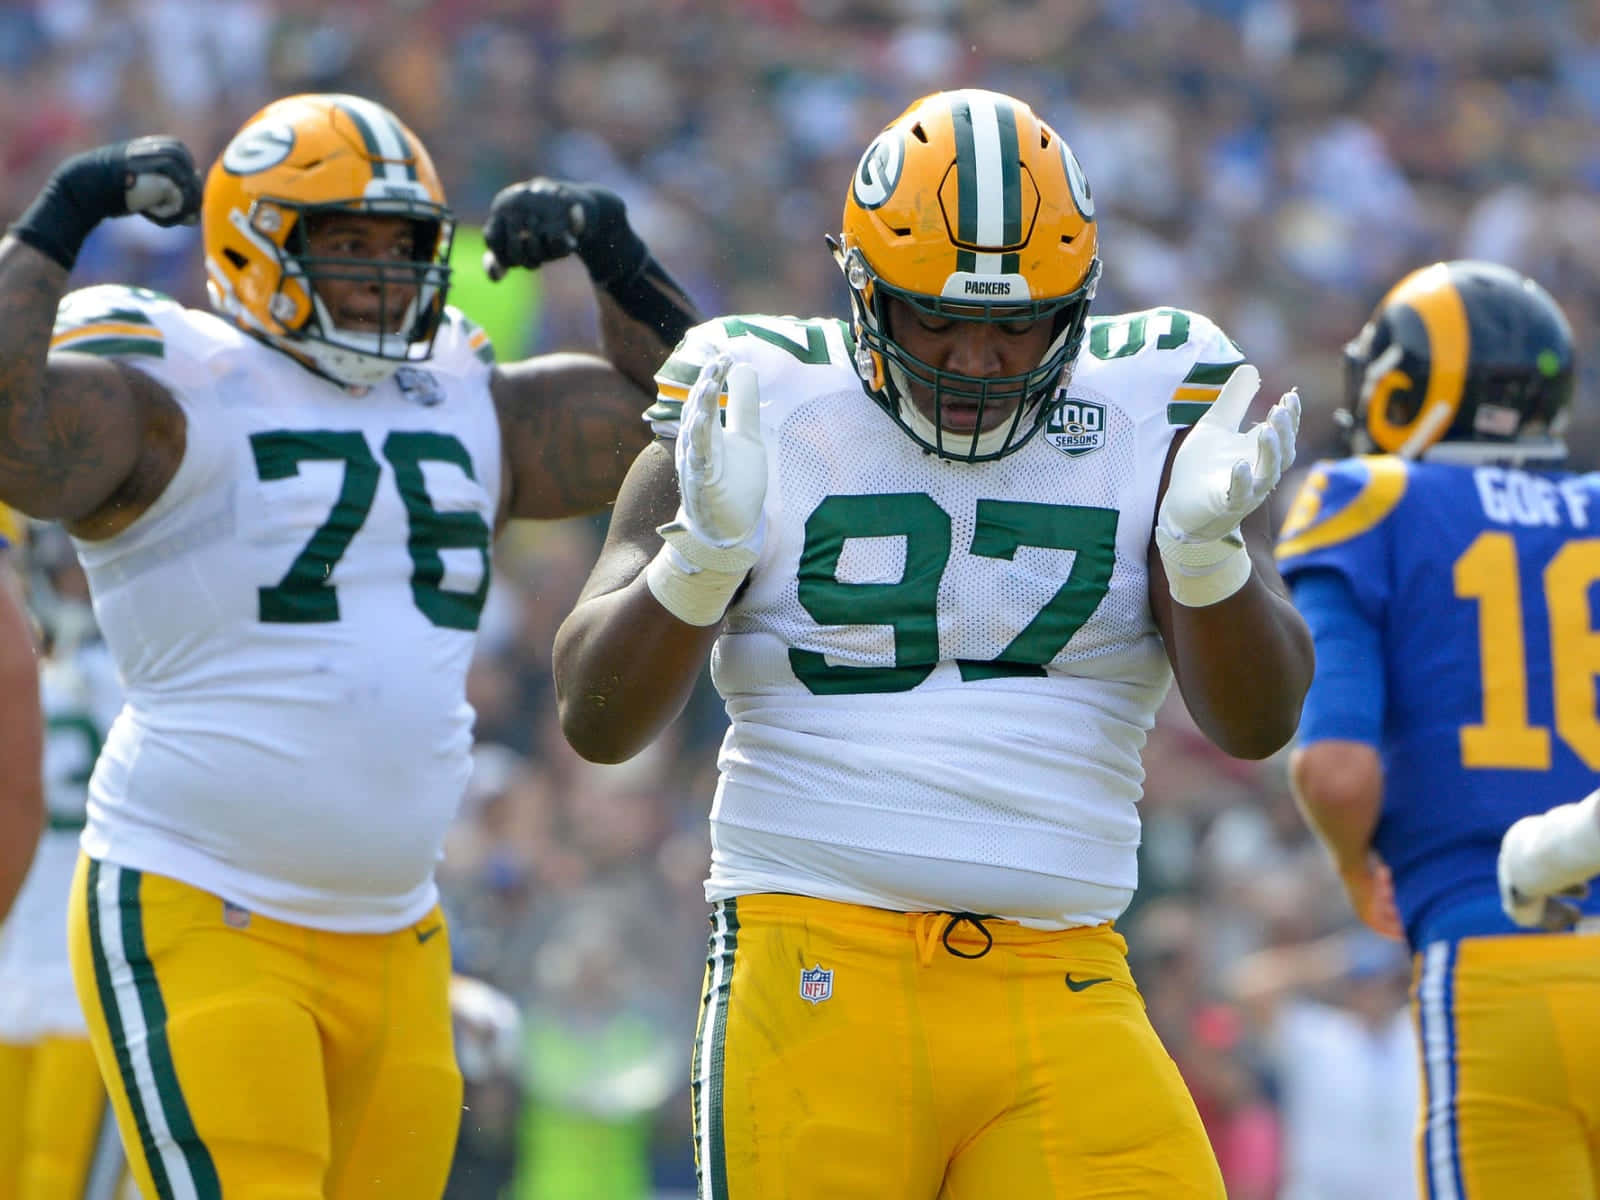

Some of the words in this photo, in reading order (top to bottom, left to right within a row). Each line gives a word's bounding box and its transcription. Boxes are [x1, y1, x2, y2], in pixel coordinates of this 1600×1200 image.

[964, 280, 1011, 295] PACKERS
[1050, 404, 1100, 432] 100
[1055, 434, 1098, 446] SEASONS
[1474, 466, 1600, 528] GOFF
[248, 429, 491, 632] 76
[788, 492, 1120, 695] 97
[1453, 530, 1600, 772] 16
[804, 982, 827, 997] NFL
